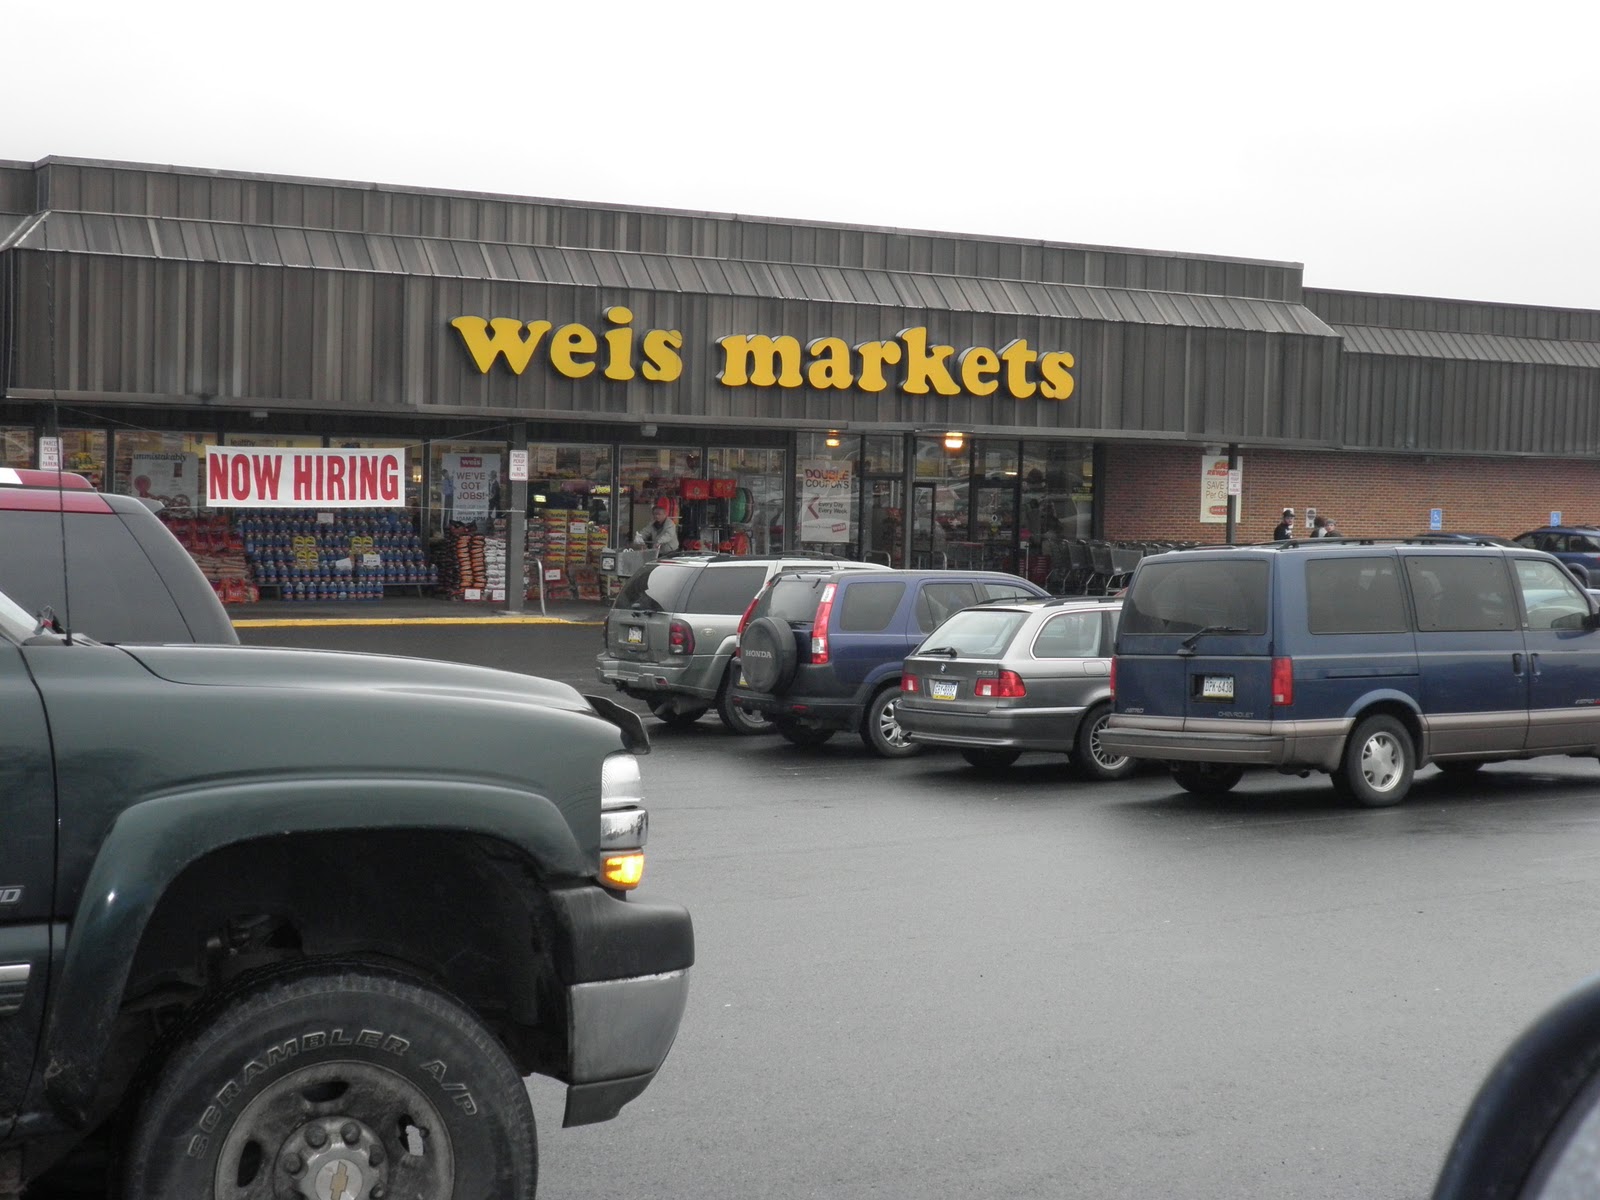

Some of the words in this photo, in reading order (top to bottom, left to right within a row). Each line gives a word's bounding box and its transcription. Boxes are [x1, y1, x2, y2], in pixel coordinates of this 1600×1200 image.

[450, 306, 683, 382] weis
[715, 326, 1075, 400] markets
[209, 453, 282, 500] NOW
[294, 454, 399, 501] HIRING
[457, 471, 486, 480] WE'VE
[805, 469, 849, 480] DOUBLE
[461, 481, 481, 490] GOT
[805, 479, 849, 489] COUPONS
[1207, 481, 1225, 490] SAVE
[457, 491, 485, 500] JOBS!
[1206, 491, 1217, 499] Per
[745, 650, 772, 659] HONDA
[188, 1029, 410, 1159] SCRAMBLER
